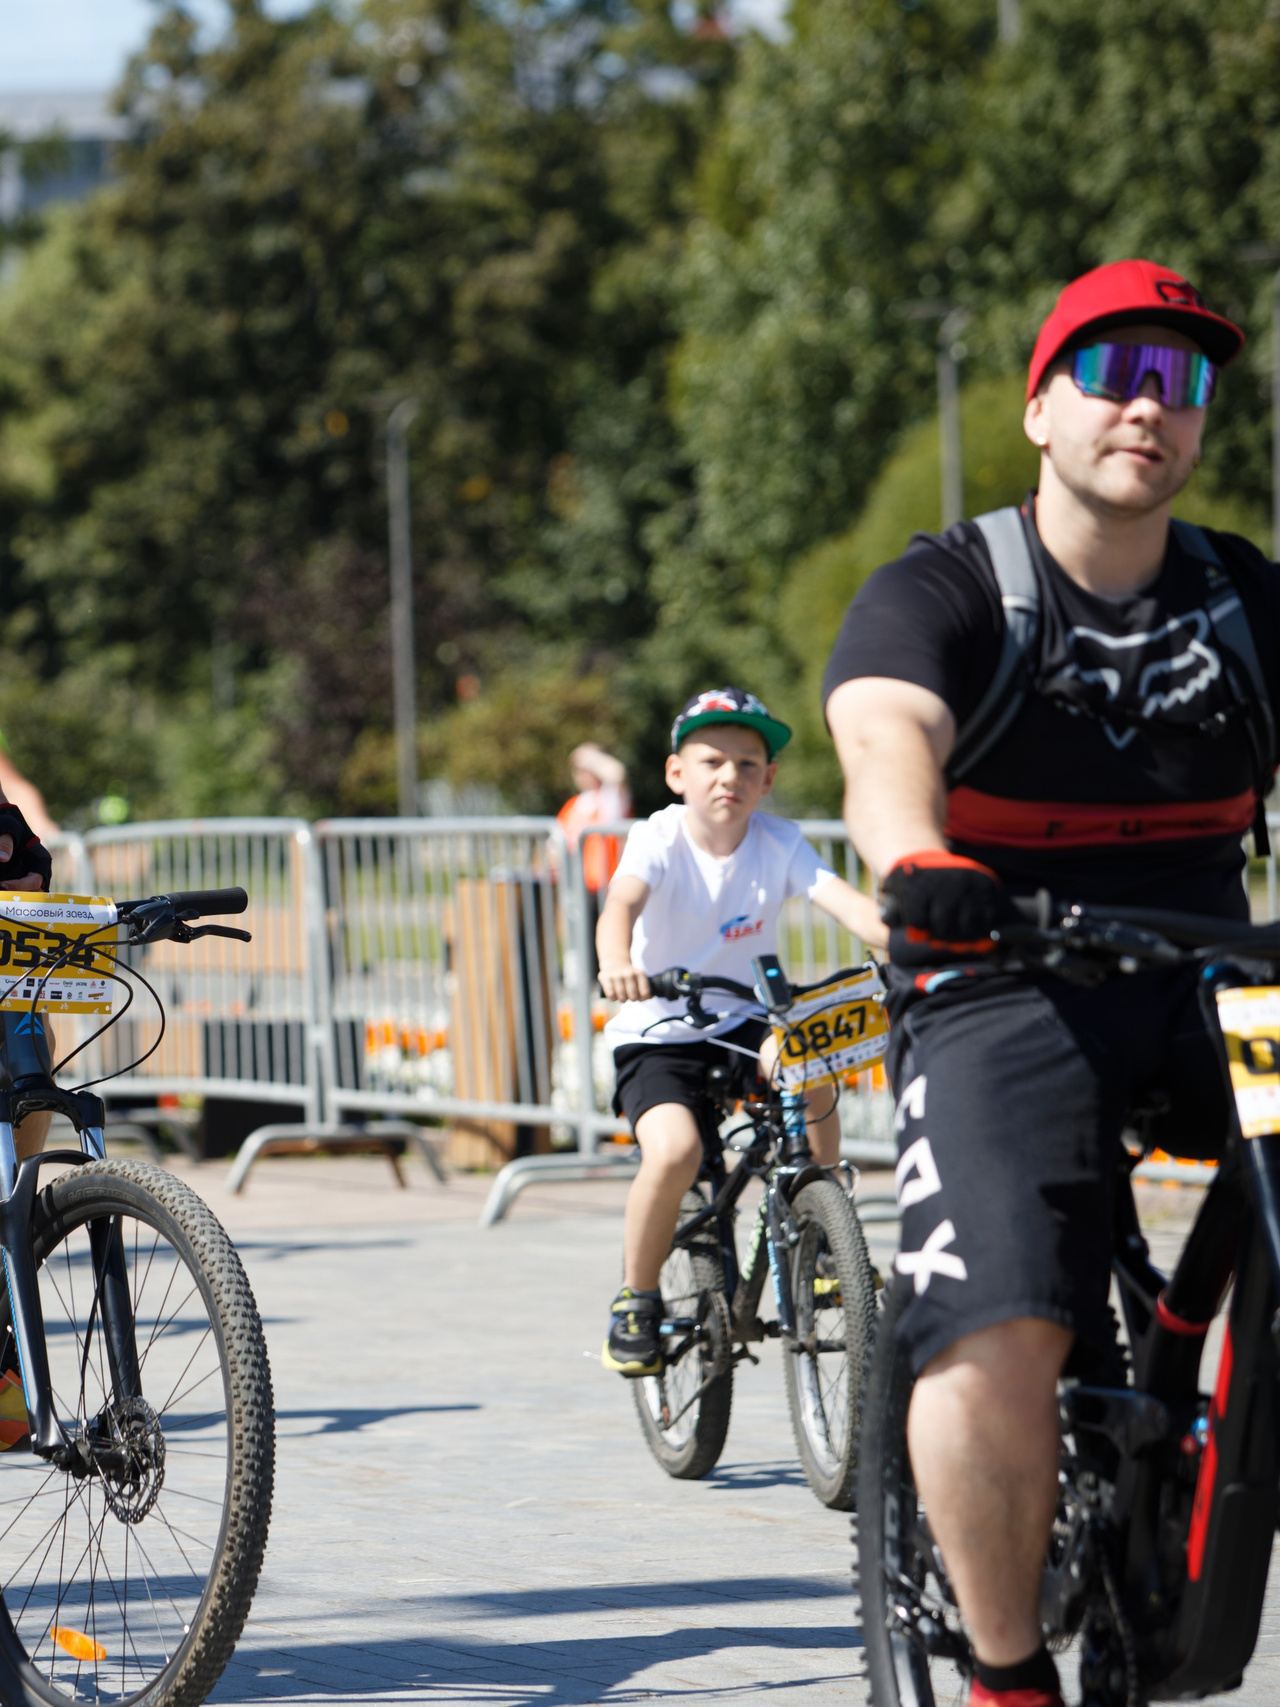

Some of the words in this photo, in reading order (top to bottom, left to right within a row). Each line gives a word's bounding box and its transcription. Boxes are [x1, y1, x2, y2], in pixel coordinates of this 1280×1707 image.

[5, 905, 64, 918] Массовый
[66, 910, 95, 920] заезд
[784, 1005, 867, 1057] 0847
[894, 1074, 968, 1296] FOX
